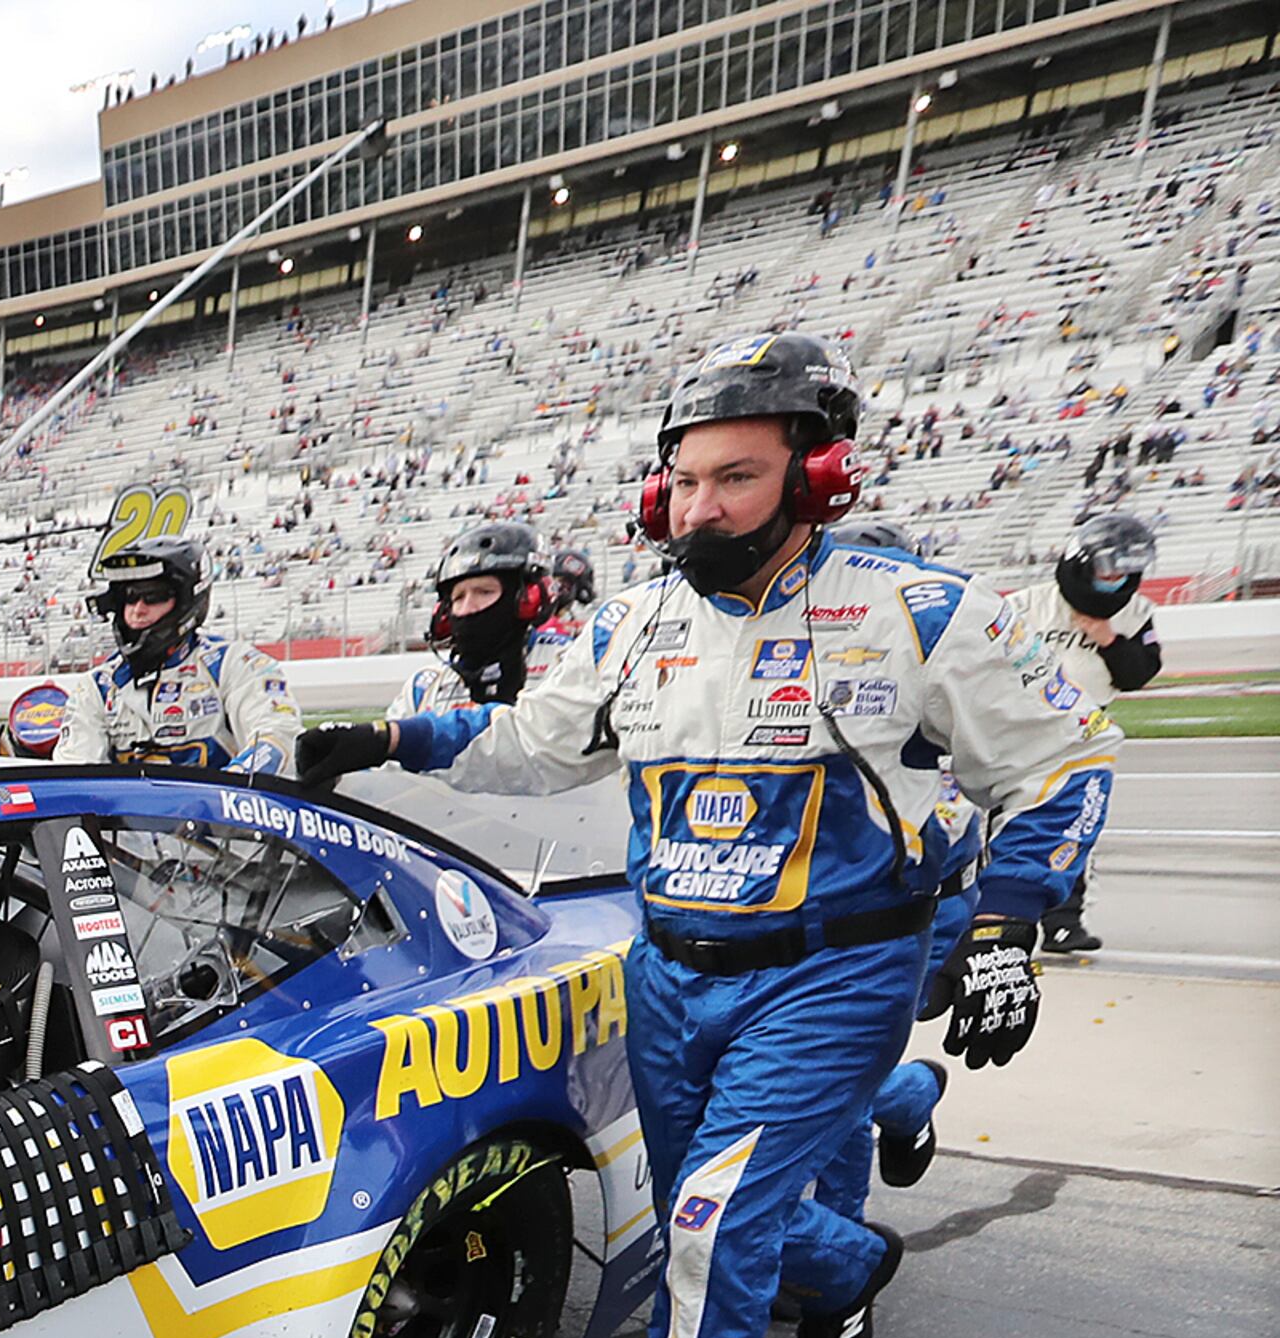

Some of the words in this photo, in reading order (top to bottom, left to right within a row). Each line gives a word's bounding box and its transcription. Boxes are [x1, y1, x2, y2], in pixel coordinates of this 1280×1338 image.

[93, 488, 191, 575] 20
[845, 555, 902, 574] NAPA
[693, 792, 744, 823] NAPA
[220, 789, 297, 837] Kelley
[298, 807, 353, 847] Blue
[355, 822, 411, 865] Book
[62, 857, 107, 873] AXALTA
[65, 874, 114, 893] Acronis
[665, 871, 746, 900] CENTER
[77, 916, 121, 933] HOOTERS
[85, 941, 134, 975] MAC
[88, 967, 137, 985] TOOLS
[98, 991, 140, 1006] SIEMENS
[369, 972, 564, 1122] AUTO
[548, 941, 633, 1057] PA
[186, 1075, 322, 1199] NAPA
[674, 1195, 720, 1232] 9
